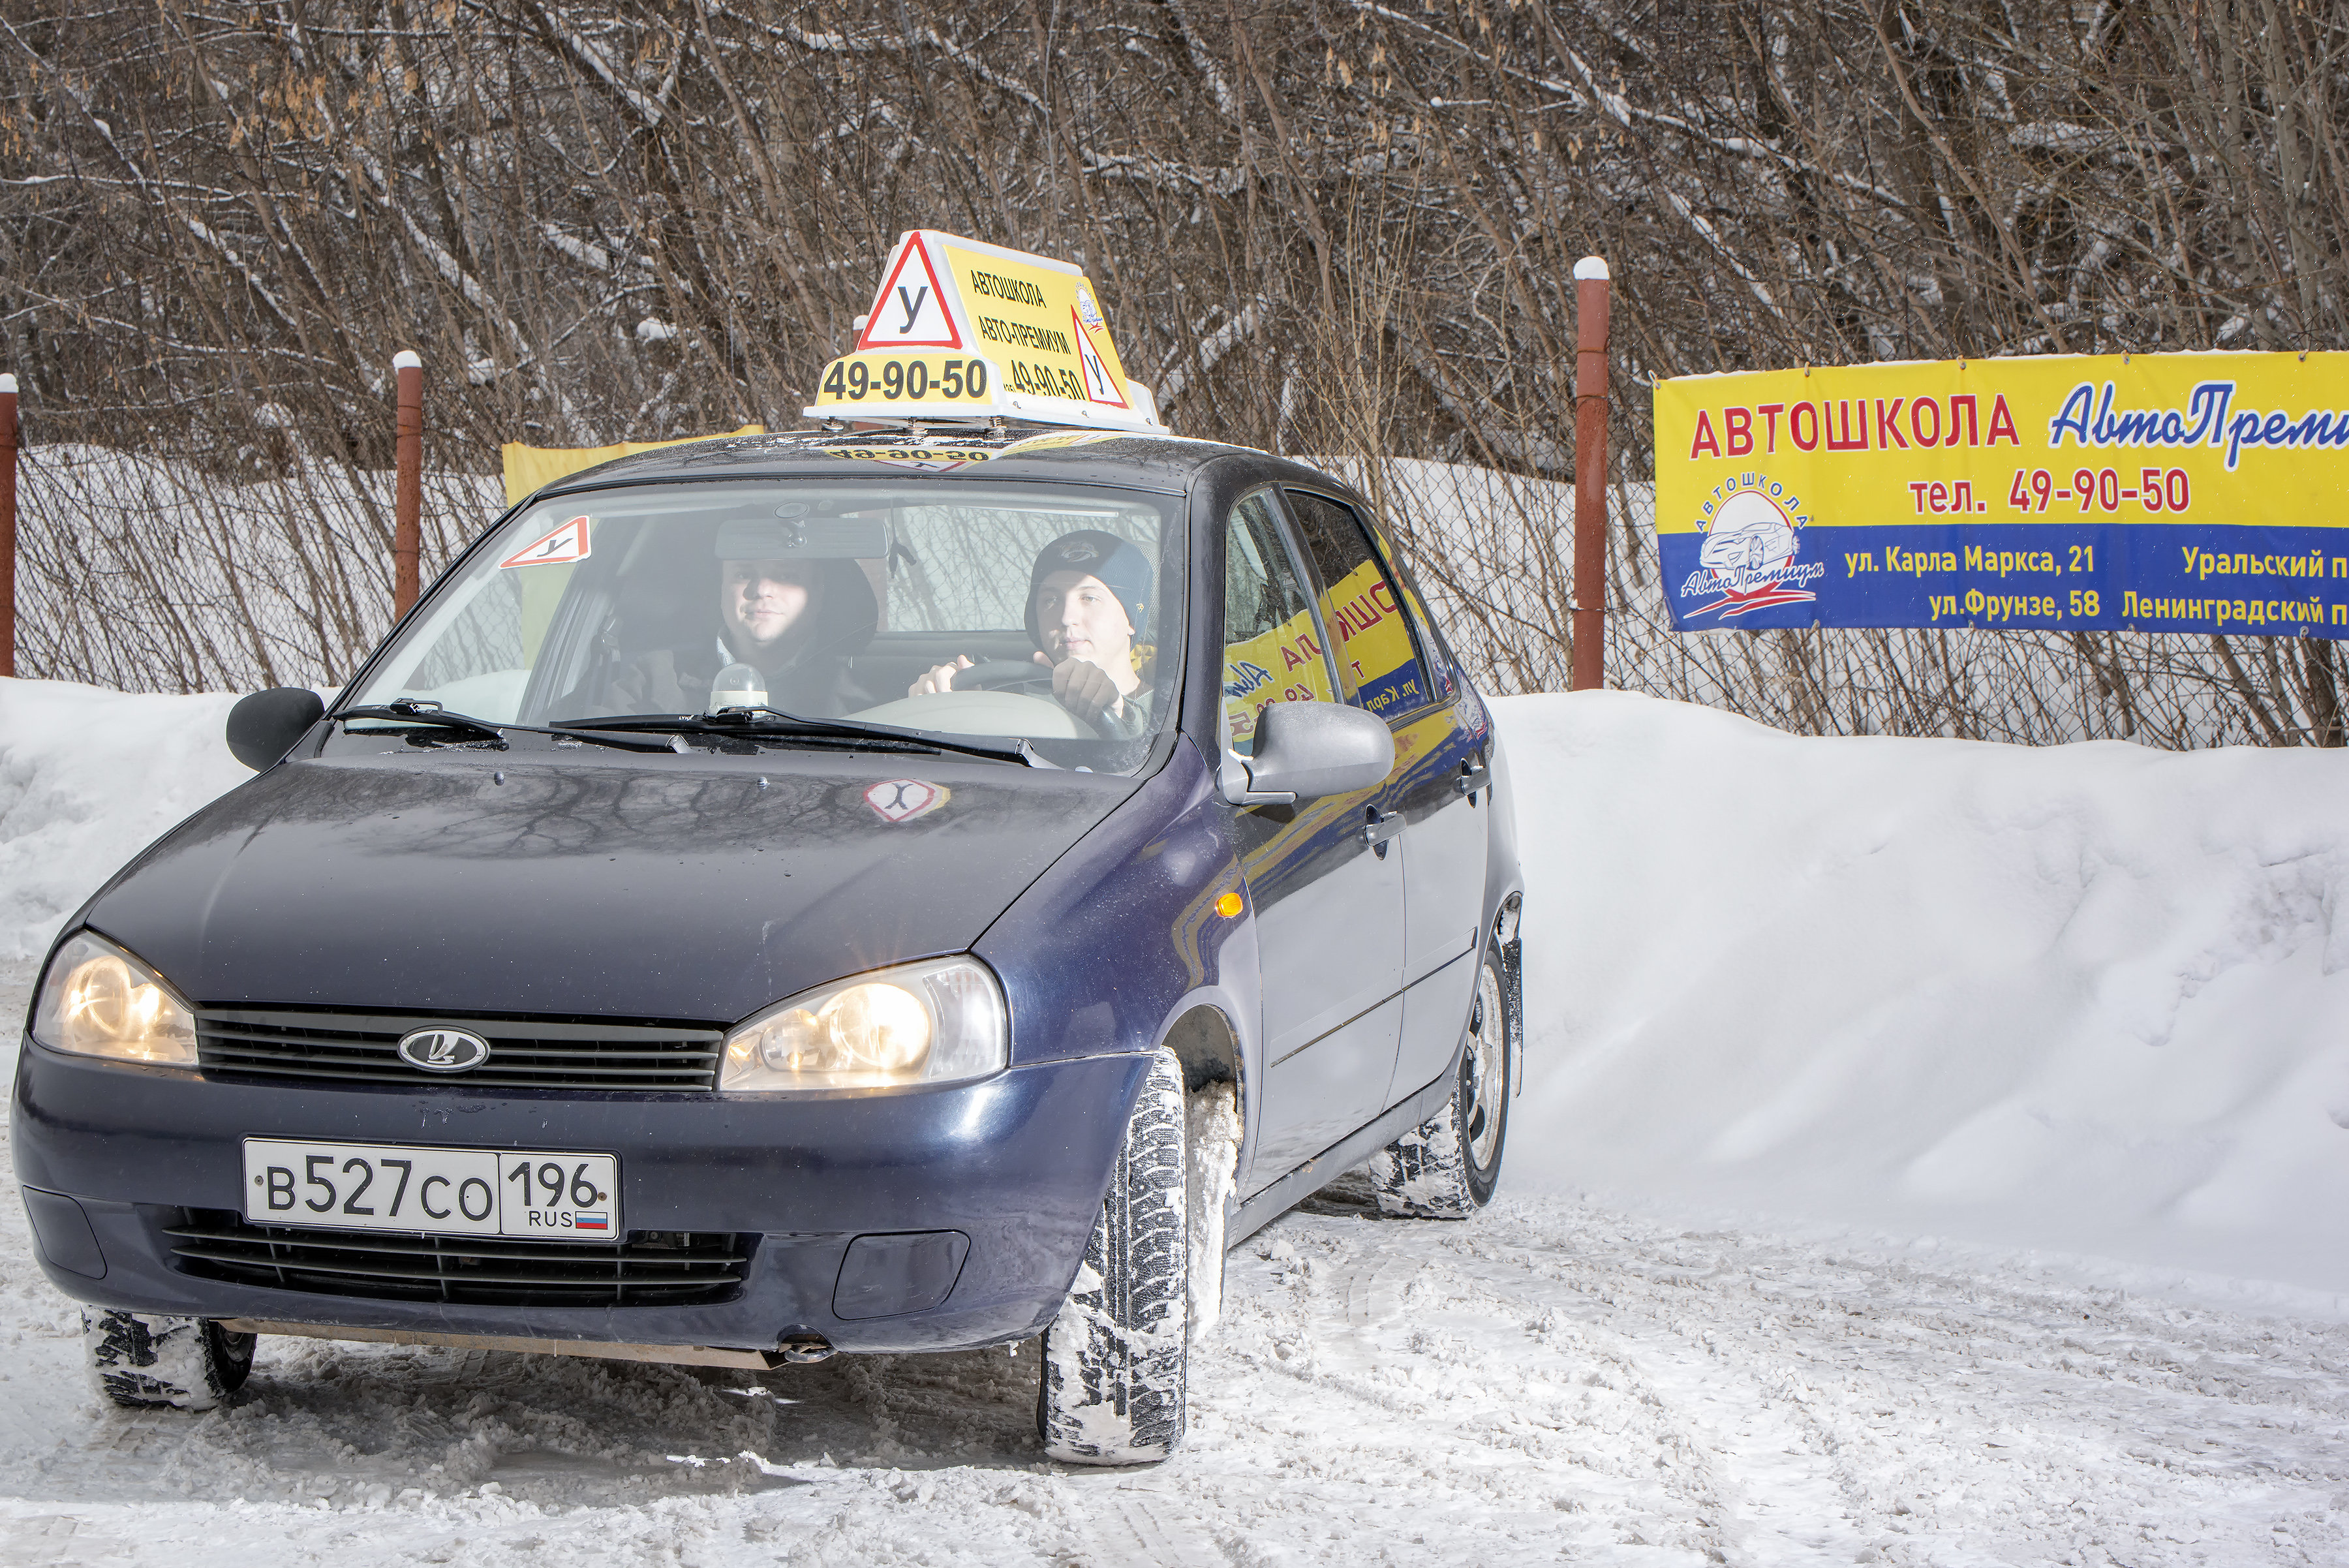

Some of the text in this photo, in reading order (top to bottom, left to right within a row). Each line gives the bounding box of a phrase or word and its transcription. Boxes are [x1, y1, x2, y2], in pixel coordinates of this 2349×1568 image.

[971, 269, 1047, 309] АВТОШКОЛА
[897, 286, 928, 333] У
[978, 315, 1071, 355] АВТО-ПРЕМИУМ
[823, 359, 987, 400] 49-90-50
[1011, 360, 1086, 401] 49-90-50
[1084, 354, 1104, 395] У
[1690, 394, 2020, 460] АВТОШКОЛА
[1695, 471, 1809, 533] АВТОШКОЛА
[1908, 467, 2191, 514] тел. 49-90-50
[536, 538, 574, 558] У
[1845, 546, 2094, 577] ул. Карла Маркса, 21
[2182, 546, 2324, 580] Уральский
[1681, 560, 1824, 598] АвтоПремиум
[2070, 590, 2100, 616] 58
[2122, 591, 2324, 626] Ленинградский
[508, 1161, 598, 1207] 196
[529, 1211, 572, 1227] RUS
